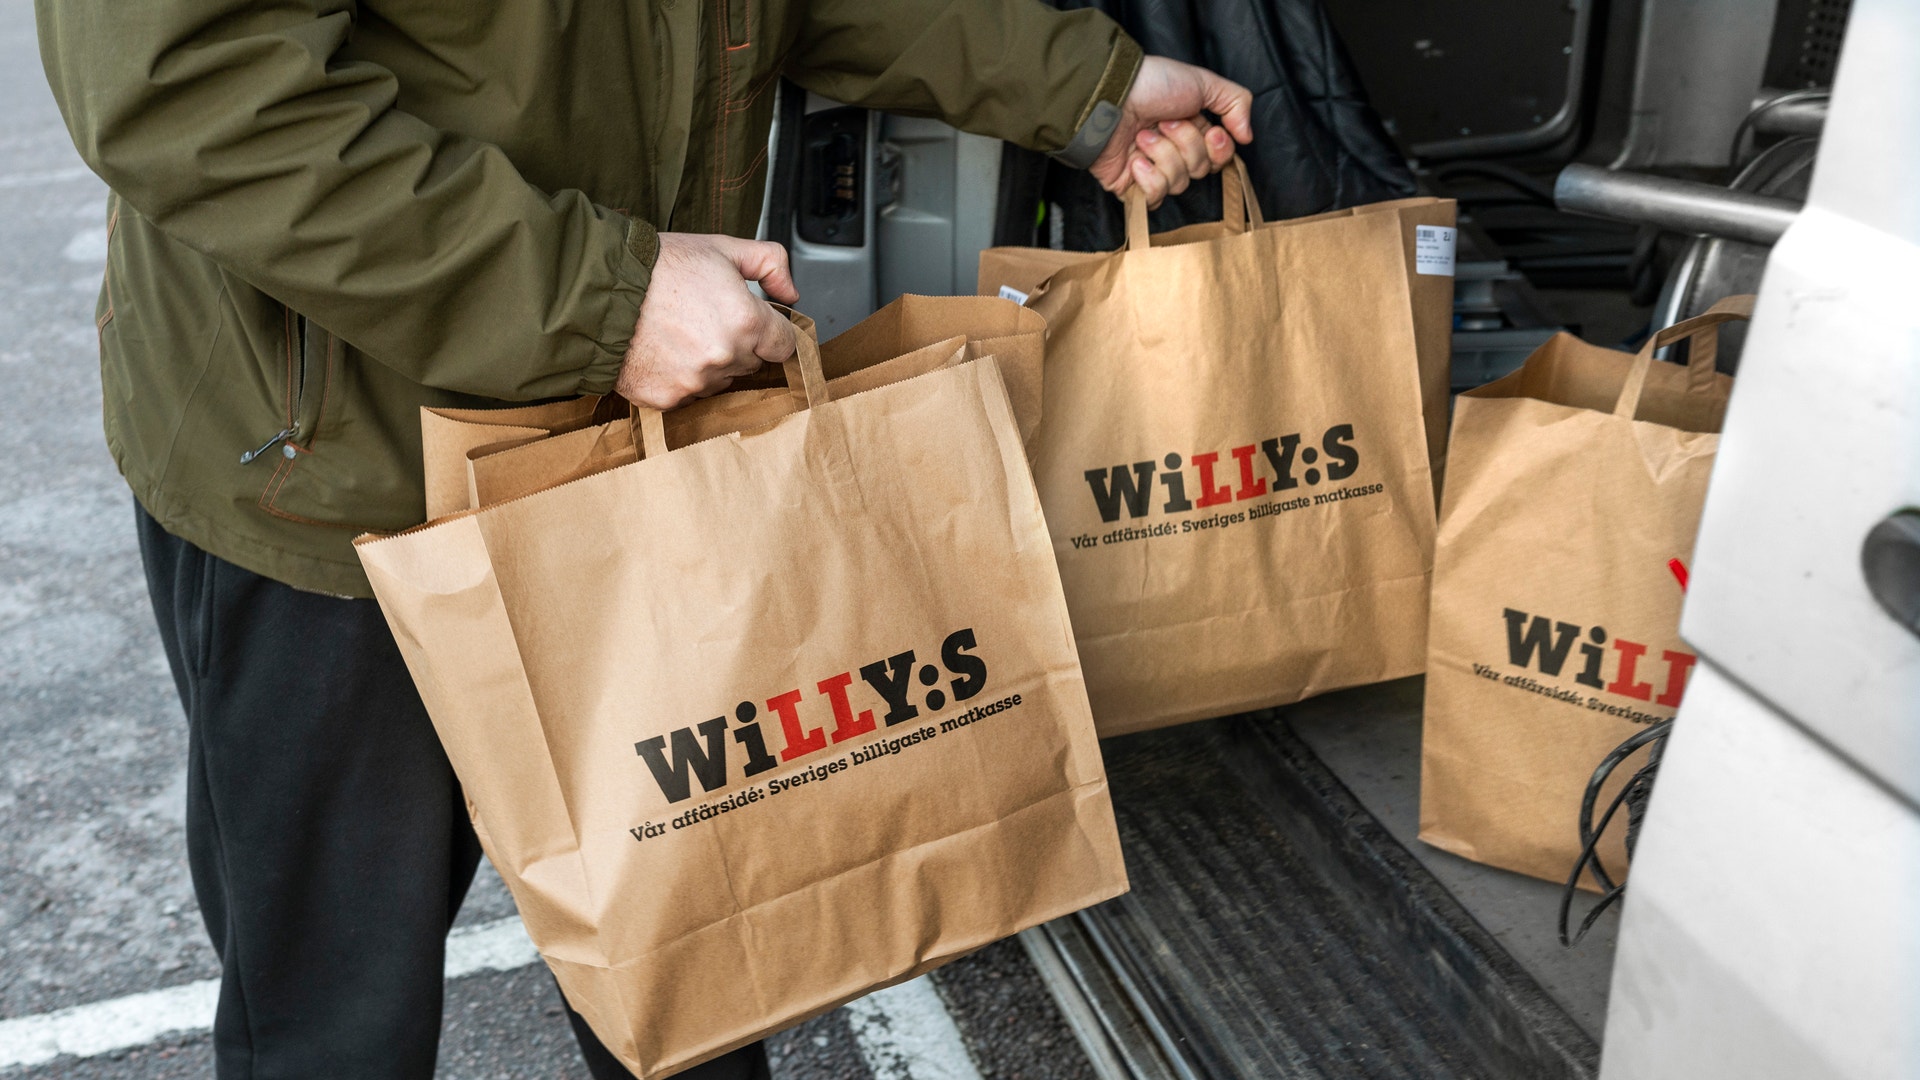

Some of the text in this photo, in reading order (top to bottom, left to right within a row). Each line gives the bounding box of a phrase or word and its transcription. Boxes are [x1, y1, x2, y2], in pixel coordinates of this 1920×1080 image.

[1071, 483, 1384, 549] Vår affärsidé: Sveriges billigaste matkasse
[1084, 423, 1360, 523] WiLLY:S
[1502, 607, 1697, 709] WiLL
[634, 628, 988, 804] WiLLY:S
[629, 693, 1022, 842] Vår affärsidé: Sveriges billigaste matkasse
